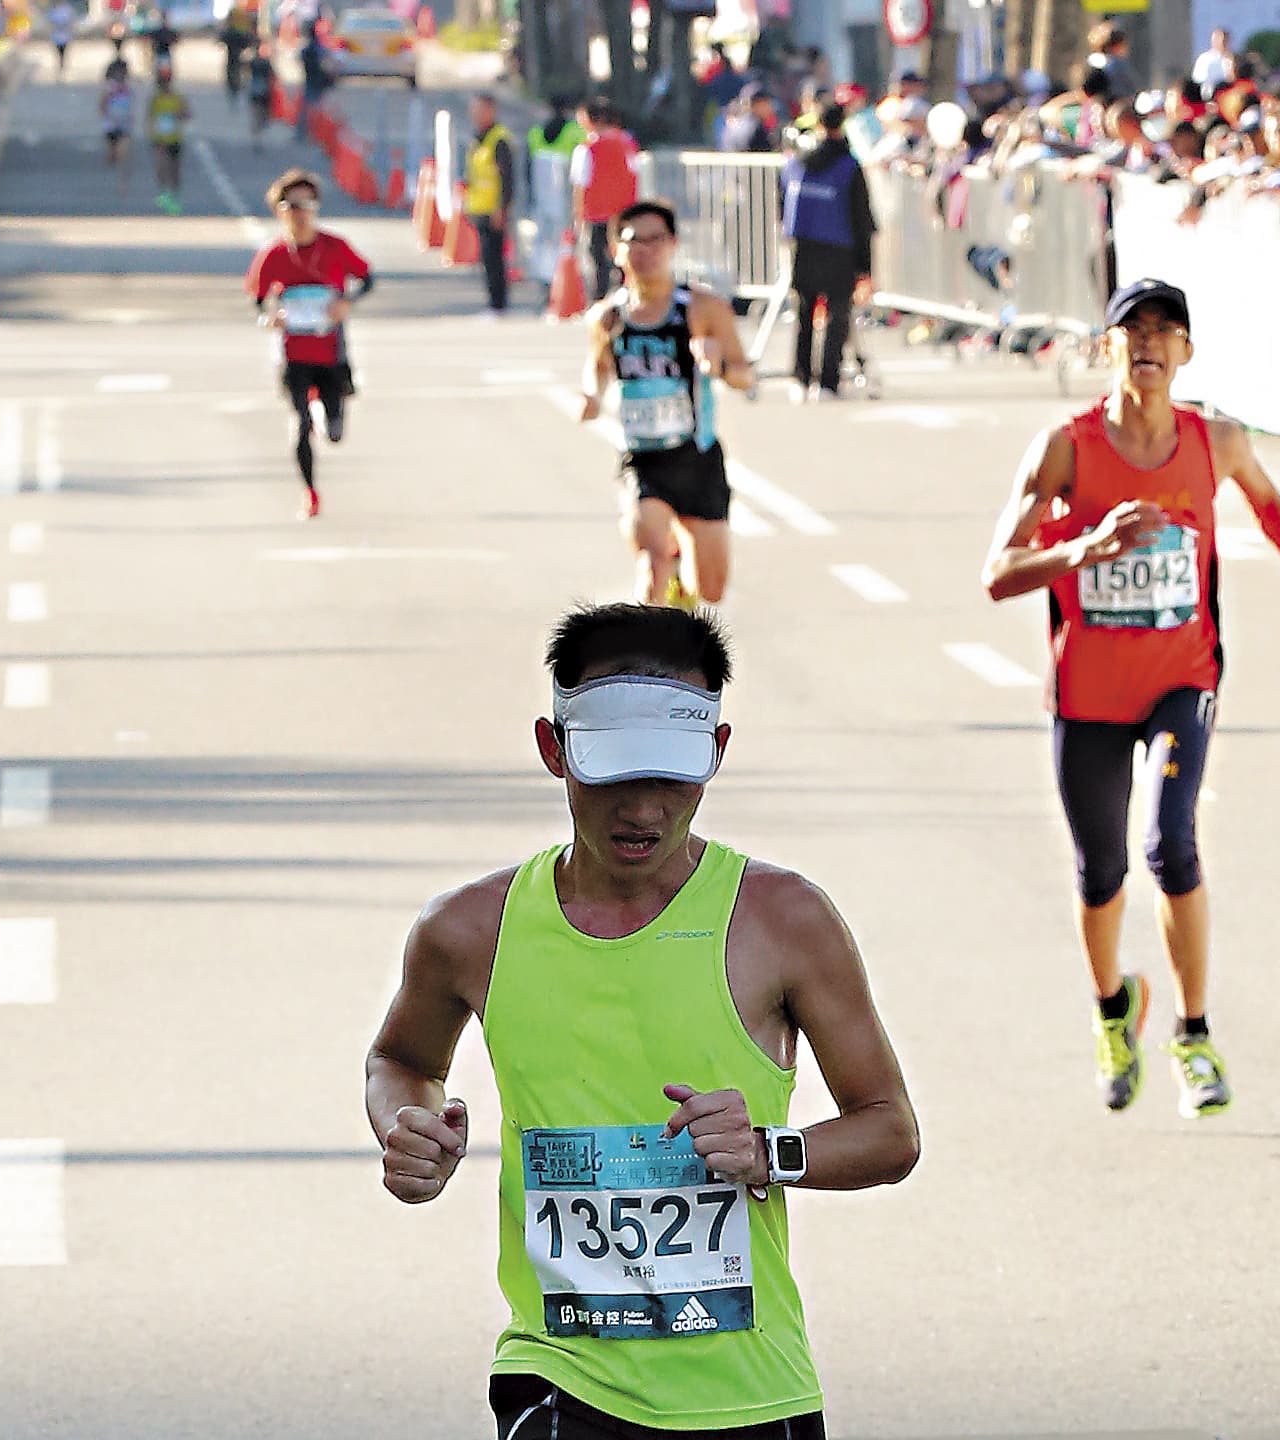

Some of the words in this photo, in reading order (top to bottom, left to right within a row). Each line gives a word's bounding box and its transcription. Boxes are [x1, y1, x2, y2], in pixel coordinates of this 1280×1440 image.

[1087, 555, 1192, 592] 15042
[535, 1189, 738, 1260] 13527
[671, 1318, 719, 1332] adidas
